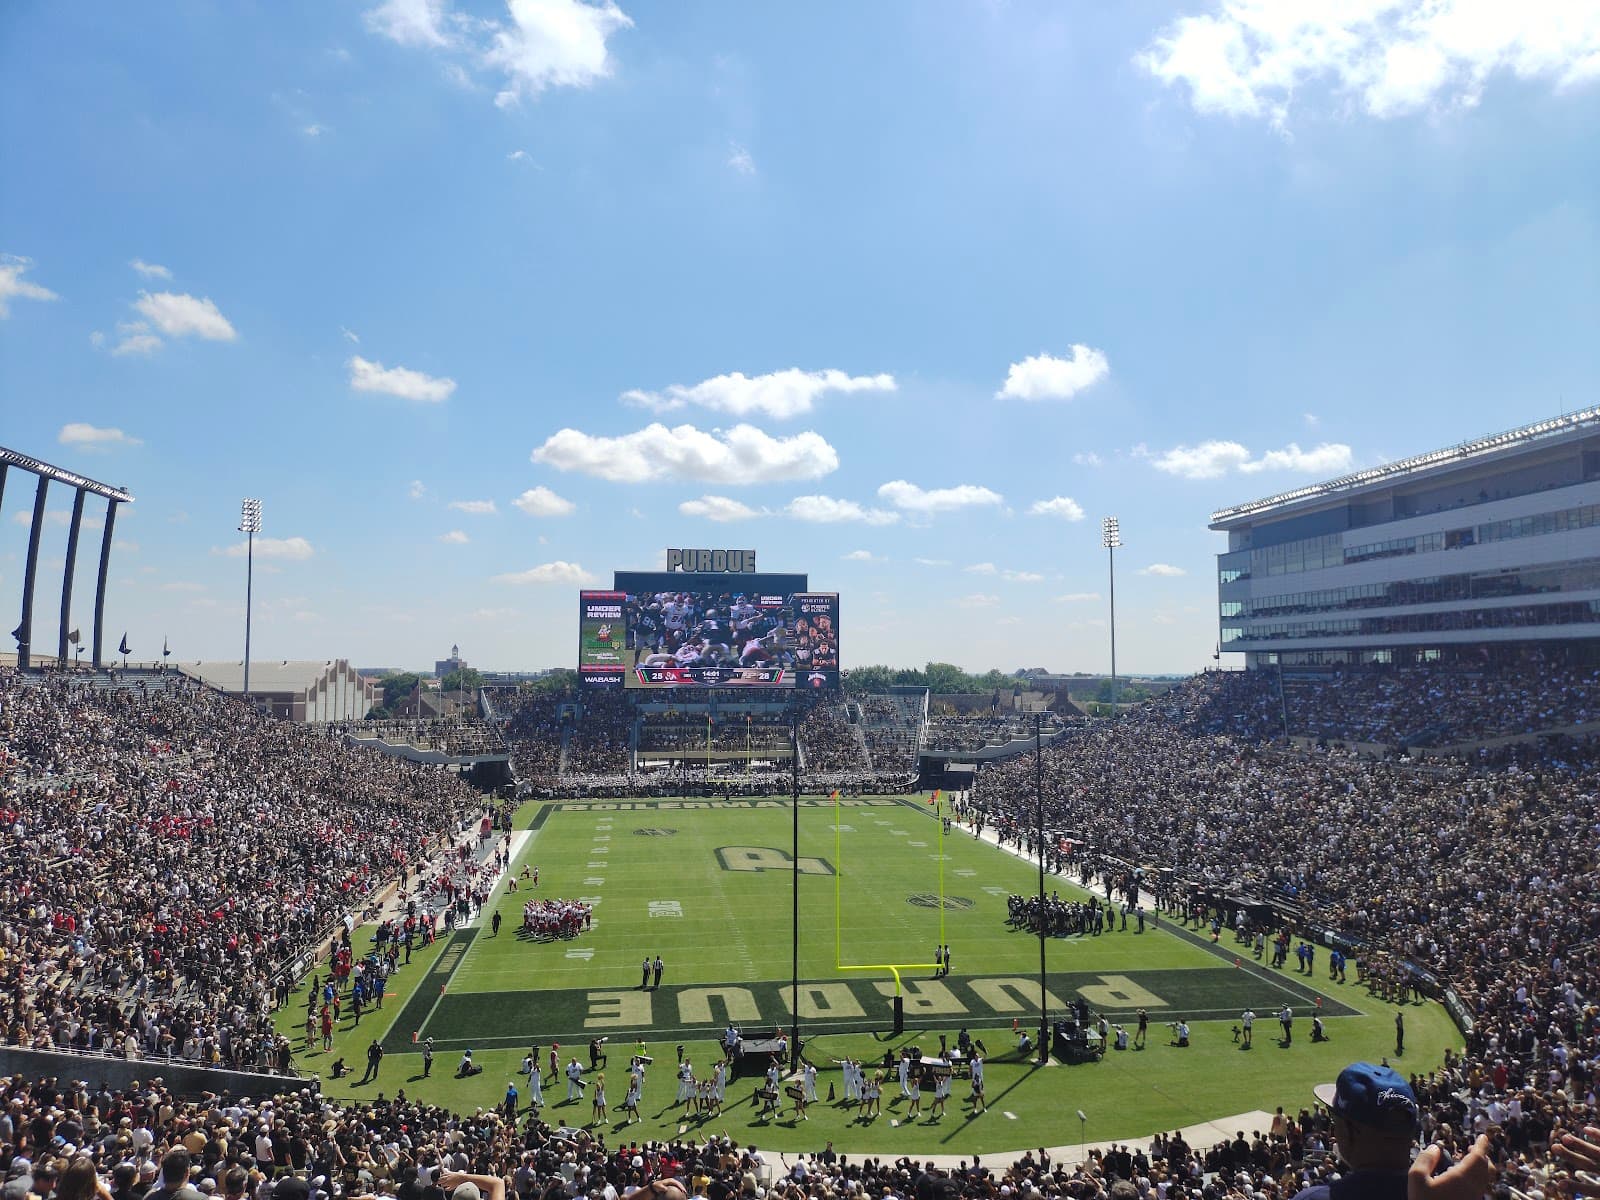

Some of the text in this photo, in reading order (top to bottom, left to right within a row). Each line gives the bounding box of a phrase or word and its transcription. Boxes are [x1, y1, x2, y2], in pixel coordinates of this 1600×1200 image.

[667, 548, 755, 573] PURDUE
[560, 800, 898, 811] BOILERMAKERS
[583, 974, 1170, 1028] PURDUE
